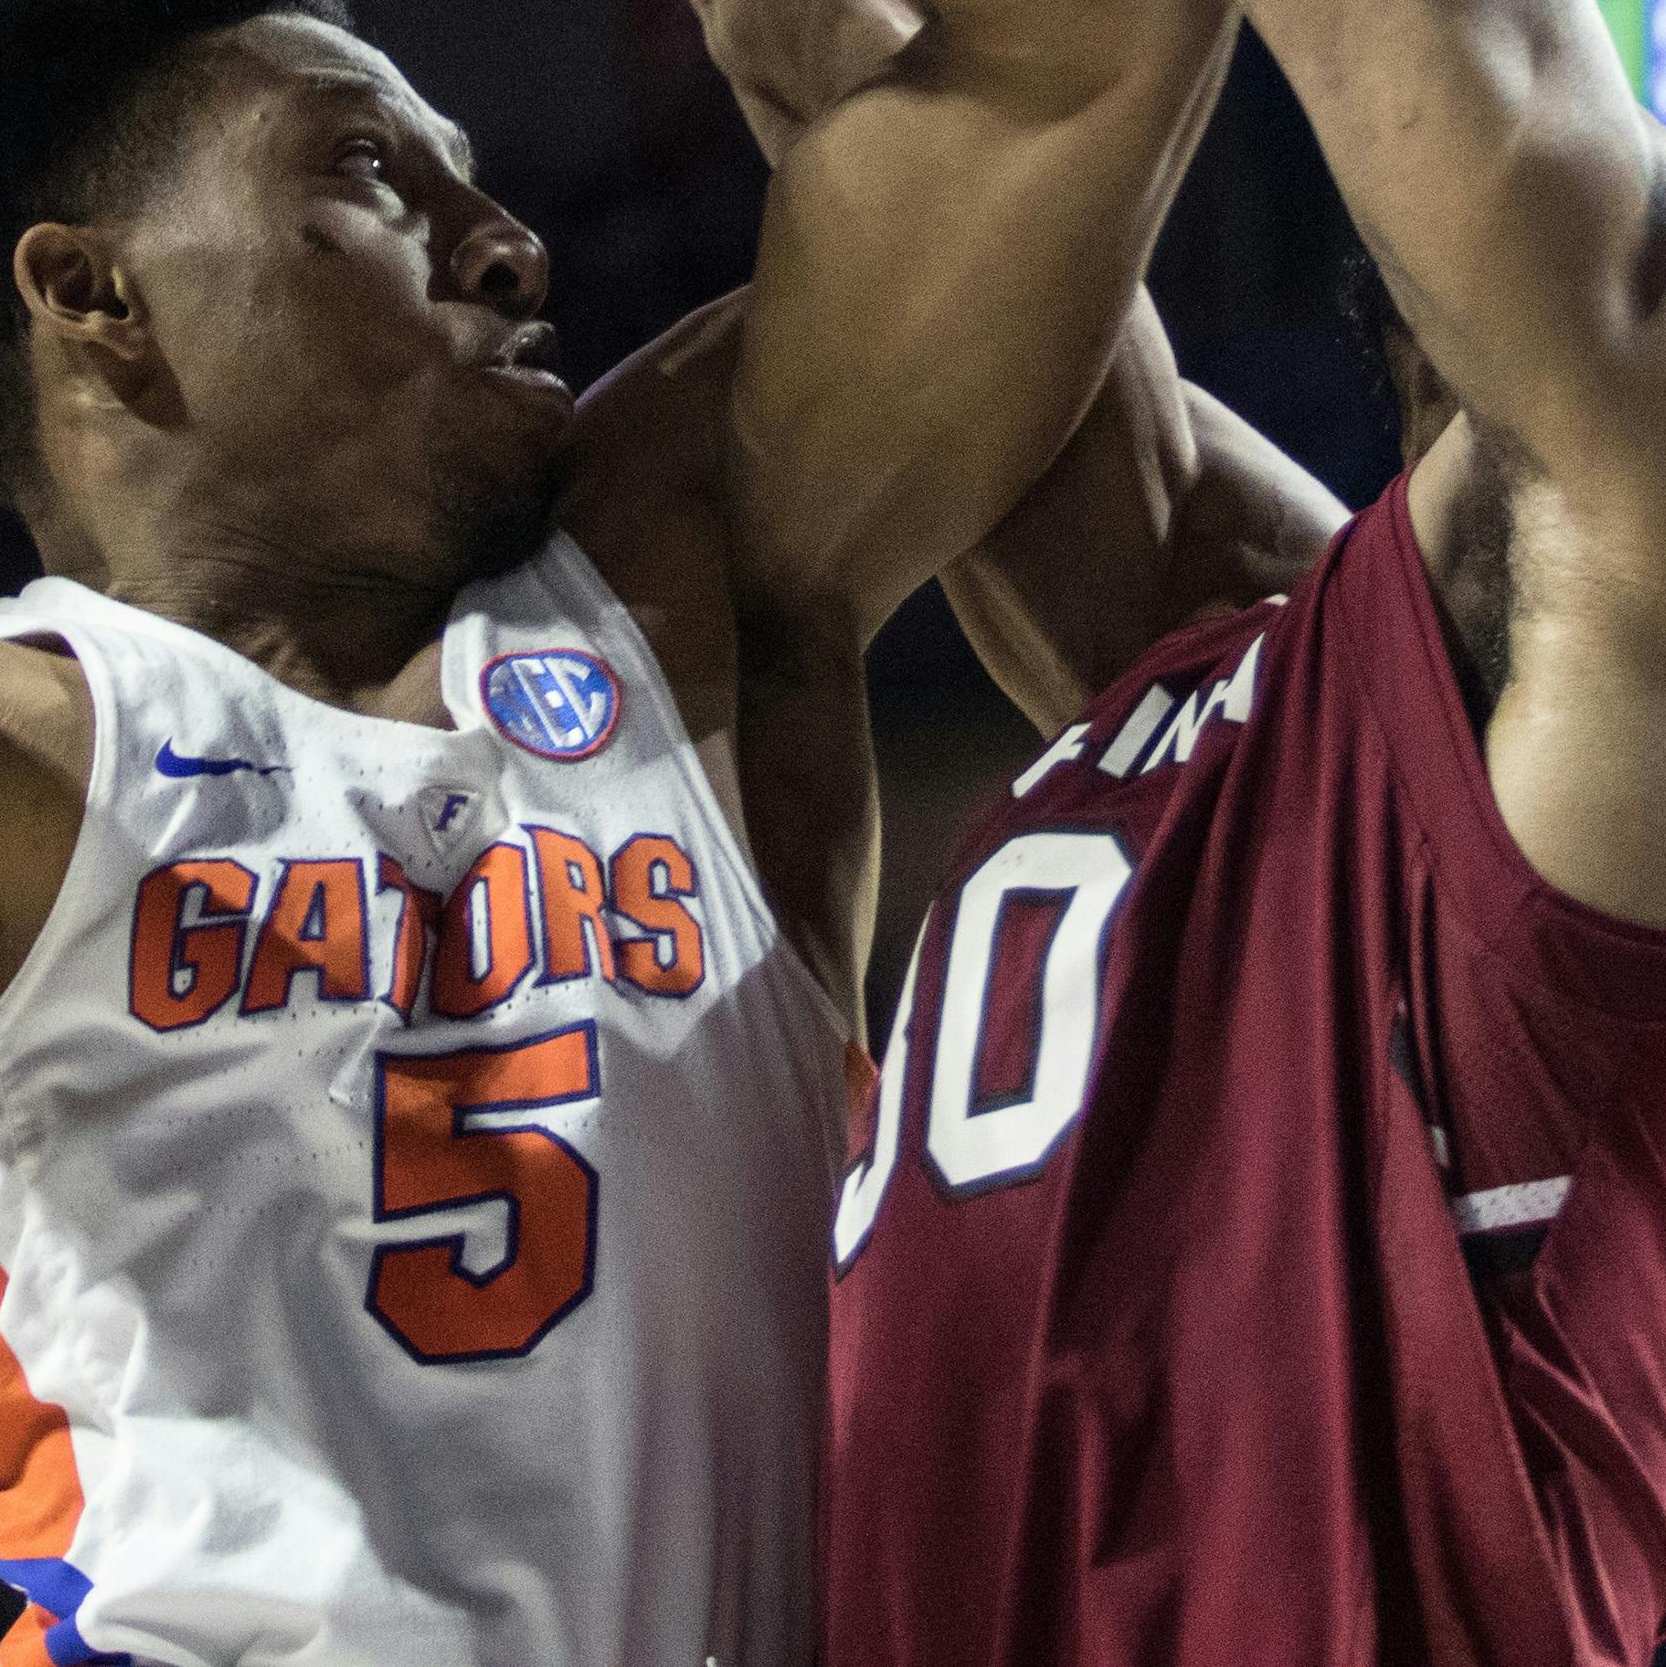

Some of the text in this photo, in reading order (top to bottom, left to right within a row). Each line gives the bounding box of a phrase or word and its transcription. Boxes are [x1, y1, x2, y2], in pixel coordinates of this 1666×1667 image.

[433, 794, 469, 831] F
[129, 822, 706, 1033] GATORS
[364, 1018, 601, 1366] 5
